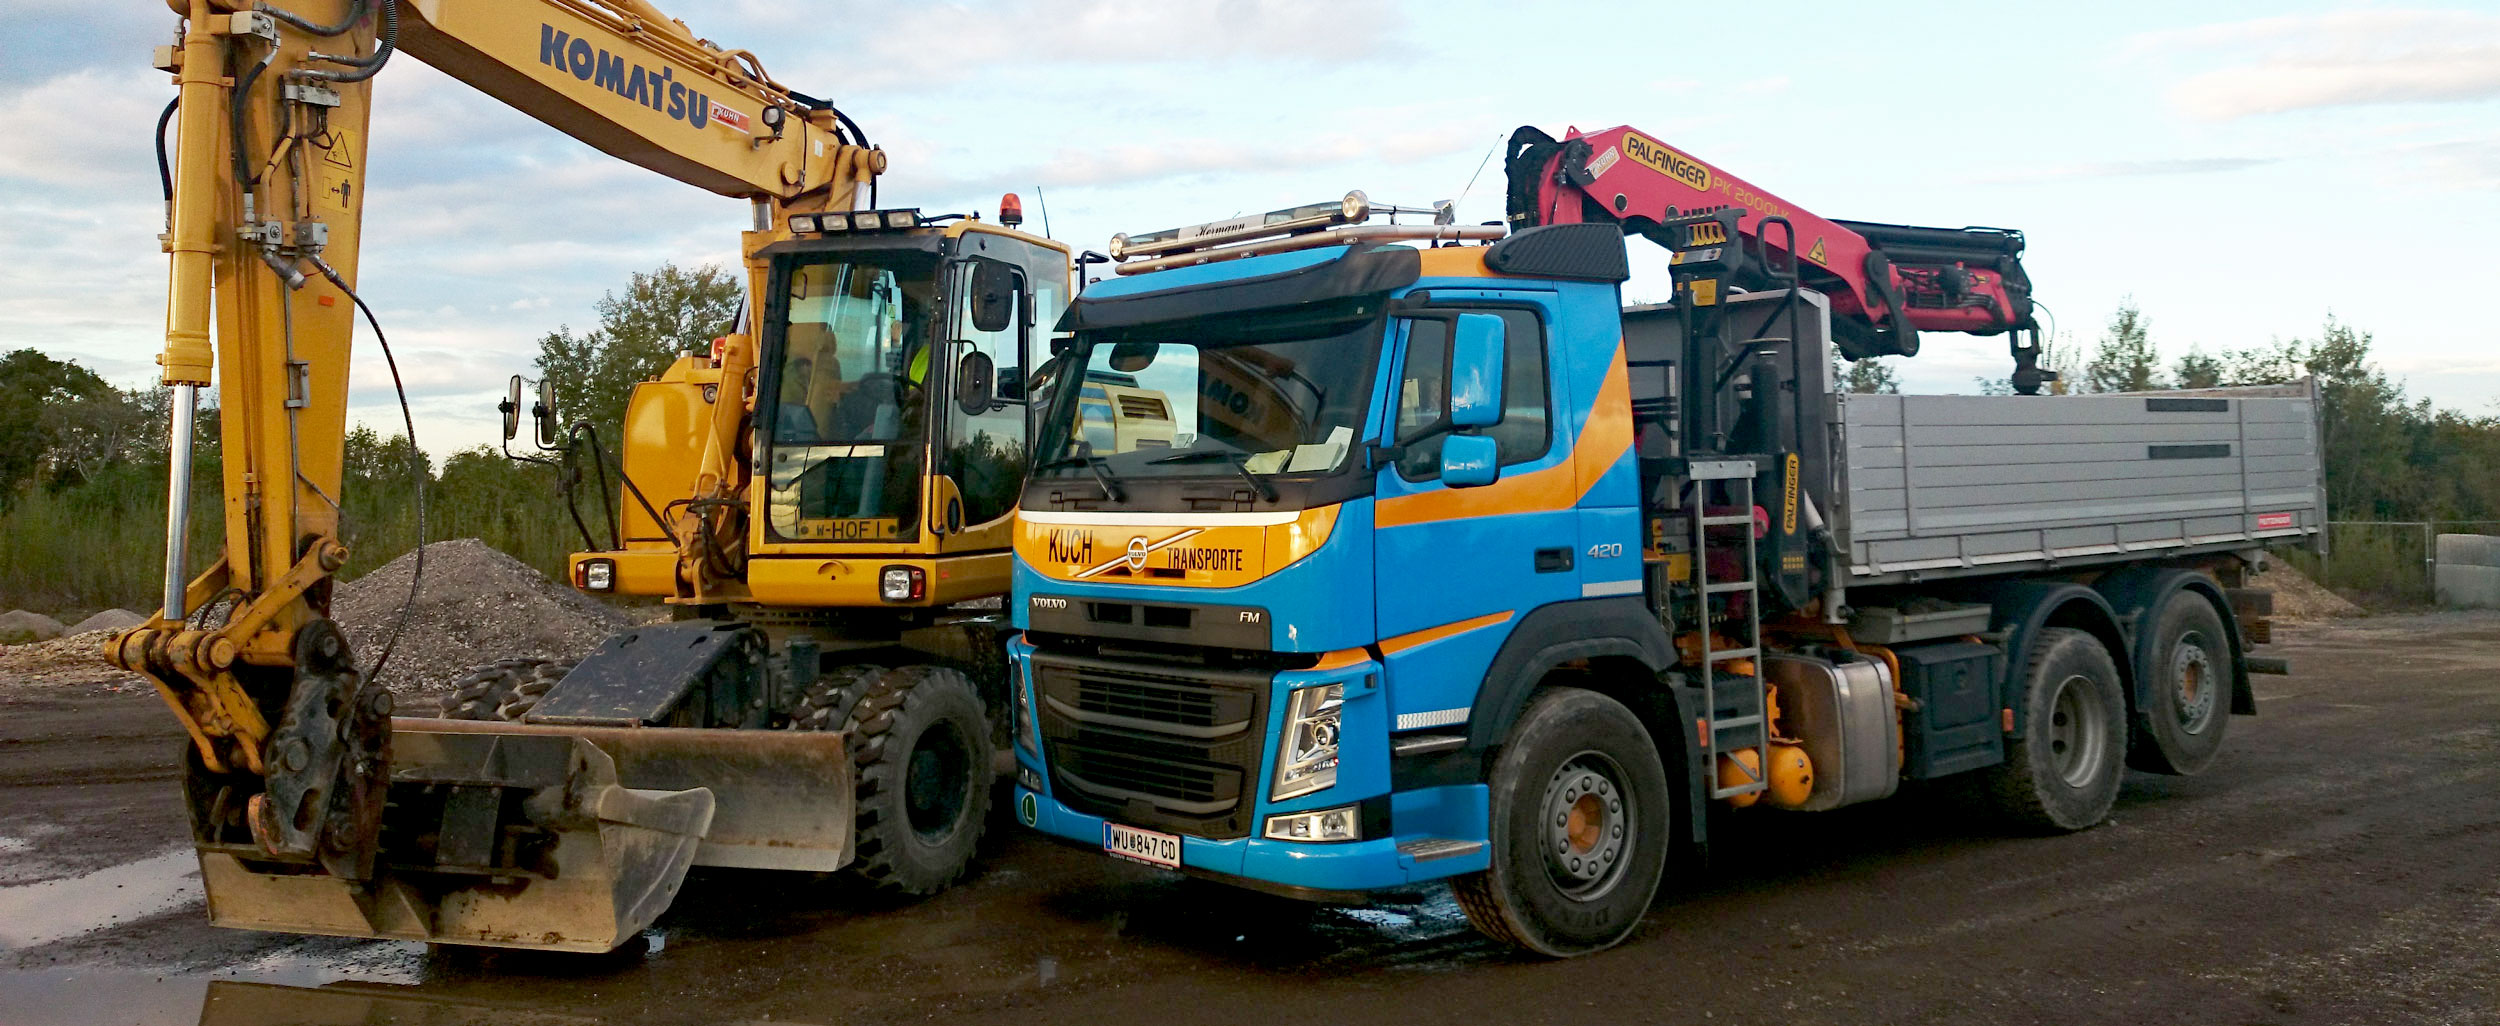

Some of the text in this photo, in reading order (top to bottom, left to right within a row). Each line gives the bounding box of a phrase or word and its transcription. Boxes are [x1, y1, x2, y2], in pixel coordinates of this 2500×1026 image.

[540, 23, 709, 130] KOMATSU
[1627, 136, 1706, 188] PALFINGER
[1713, 176, 1732, 196] PK
[1786, 459, 1797, 529] PALFINGER
[1048, 529, 1093, 564] KUCH
[1166, 547, 1243, 571] TRANSPORTE
[1587, 543, 1622, 558] 420
[1032, 598, 1067, 609] VOLVO
[1239, 612, 1260, 624] FM
[1112, 829, 1176, 860] WU 847 CD
